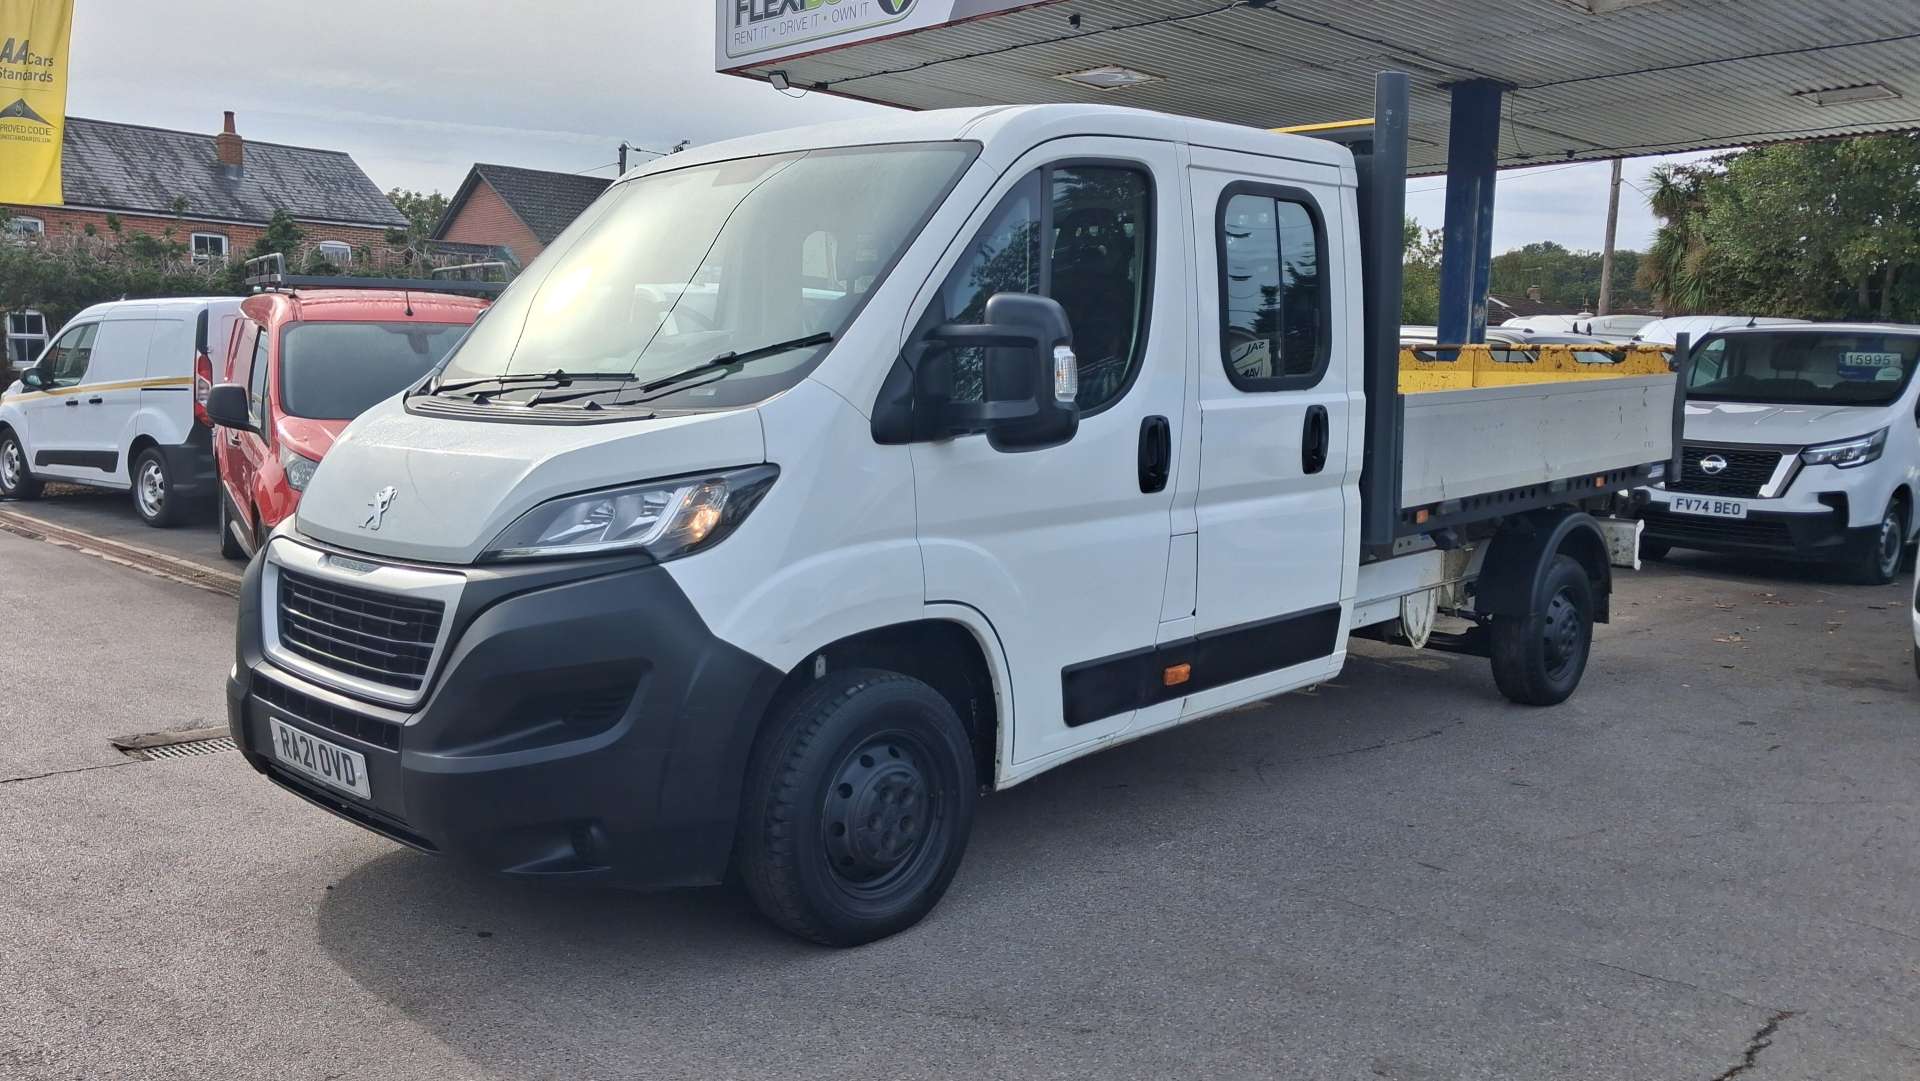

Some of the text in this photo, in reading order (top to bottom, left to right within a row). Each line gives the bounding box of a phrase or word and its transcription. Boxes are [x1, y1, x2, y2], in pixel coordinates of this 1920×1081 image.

[734, 2, 869, 47] RENT IT DRIVE IT OWN IT
[28, 126, 52, 136] CODE
[1676, 498, 1741, 515] FV74 BEO
[279, 726, 357, 787] RA21 OVD
